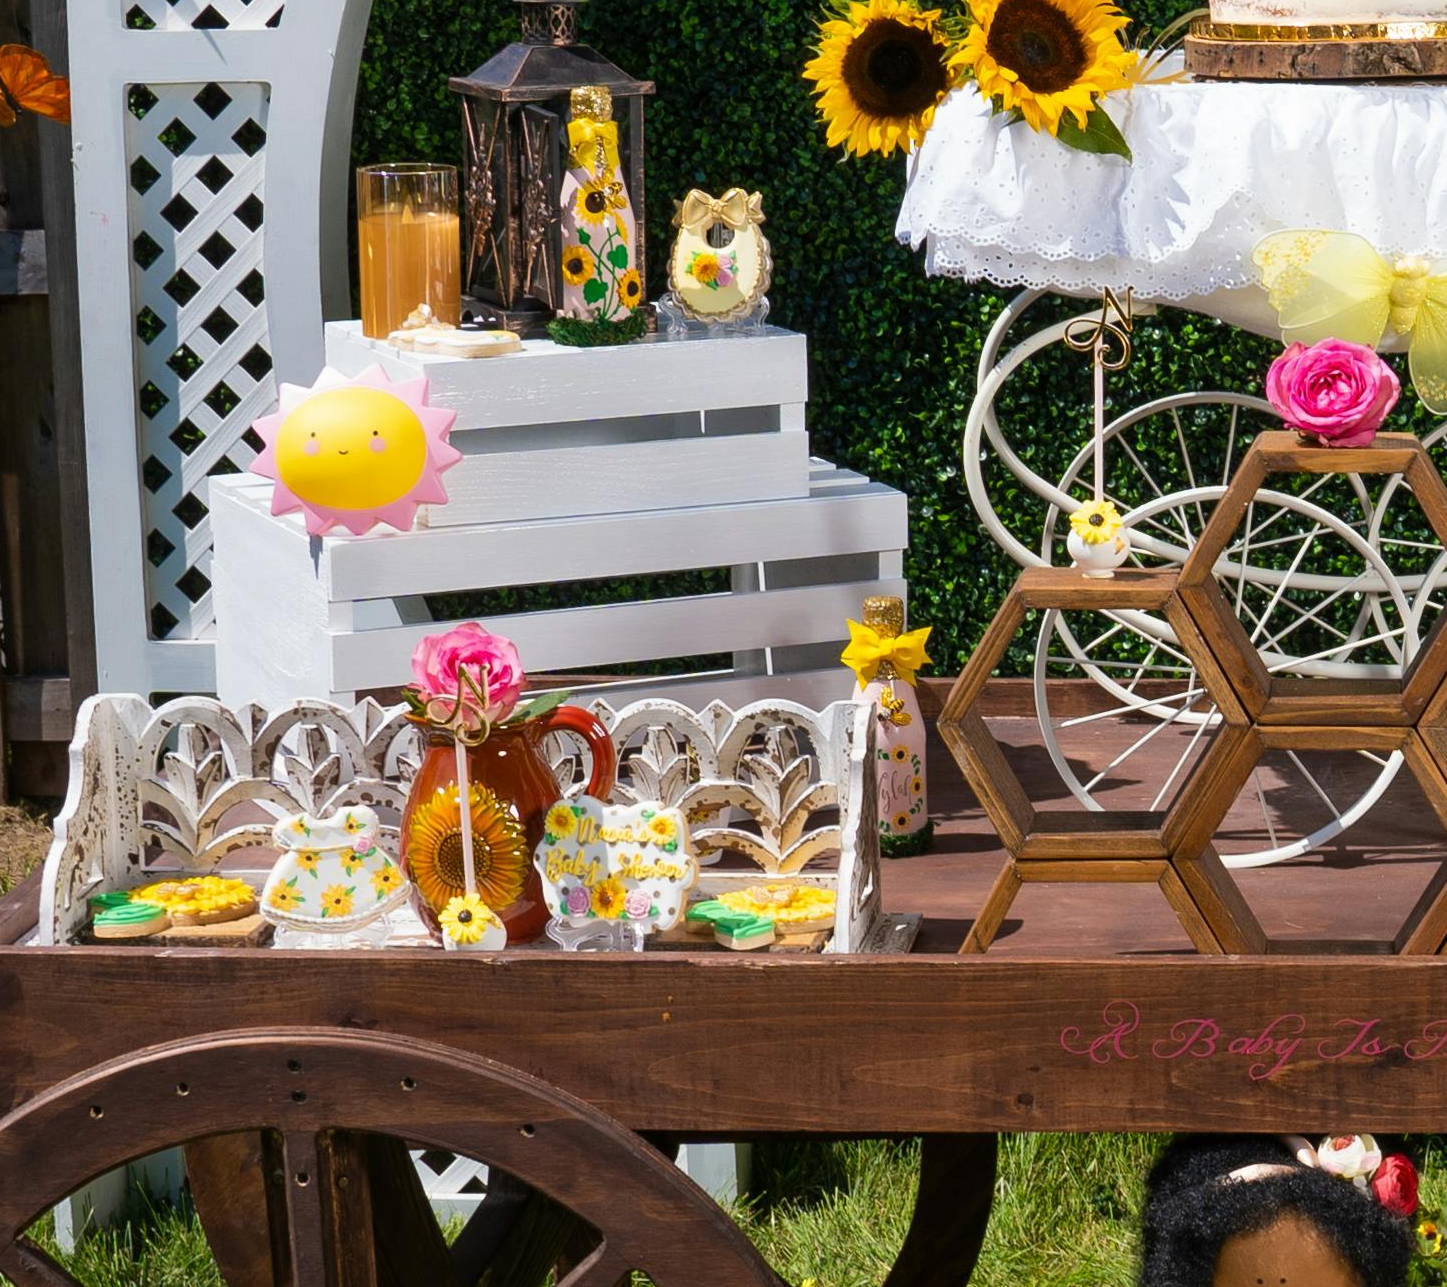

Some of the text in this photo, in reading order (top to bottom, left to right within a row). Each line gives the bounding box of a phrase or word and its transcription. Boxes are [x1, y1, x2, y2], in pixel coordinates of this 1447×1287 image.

[545, 847, 602, 888] Baby
[1060, 1000, 1140, 1064] A
[1153, 1014, 1306, 1081] Baby
[1317, 1018, 1393, 1059] Is
